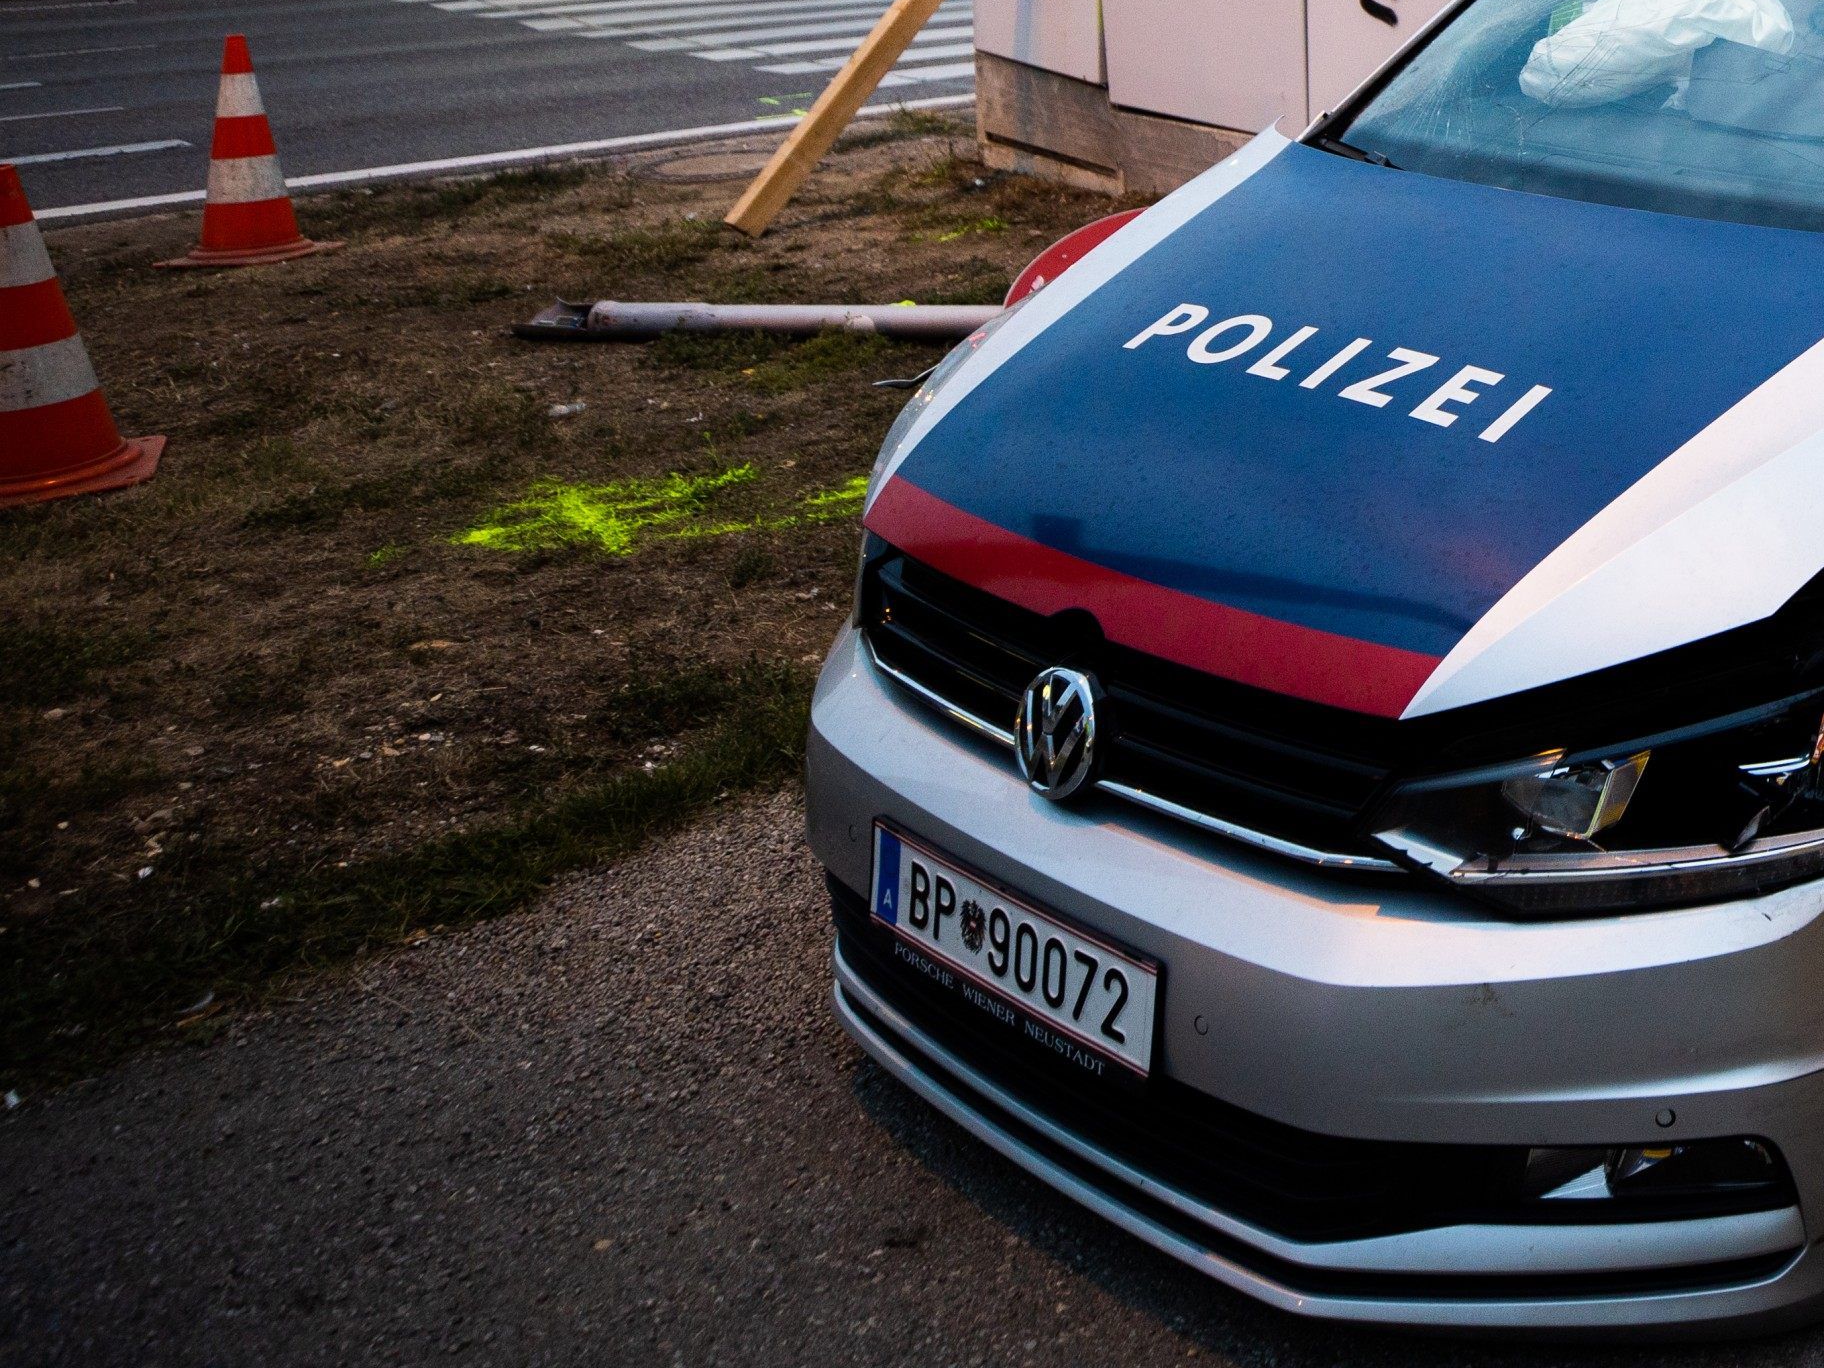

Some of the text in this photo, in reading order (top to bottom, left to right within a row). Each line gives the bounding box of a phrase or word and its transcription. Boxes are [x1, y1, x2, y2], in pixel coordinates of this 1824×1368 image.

[1122, 302, 1553, 443] POLIZEI
[882, 887, 893, 910] A
[908, 859, 1129, 1045] BP 90072
[894, 941, 1106, 1077] PORSCHE WIENER NEUSTADT
